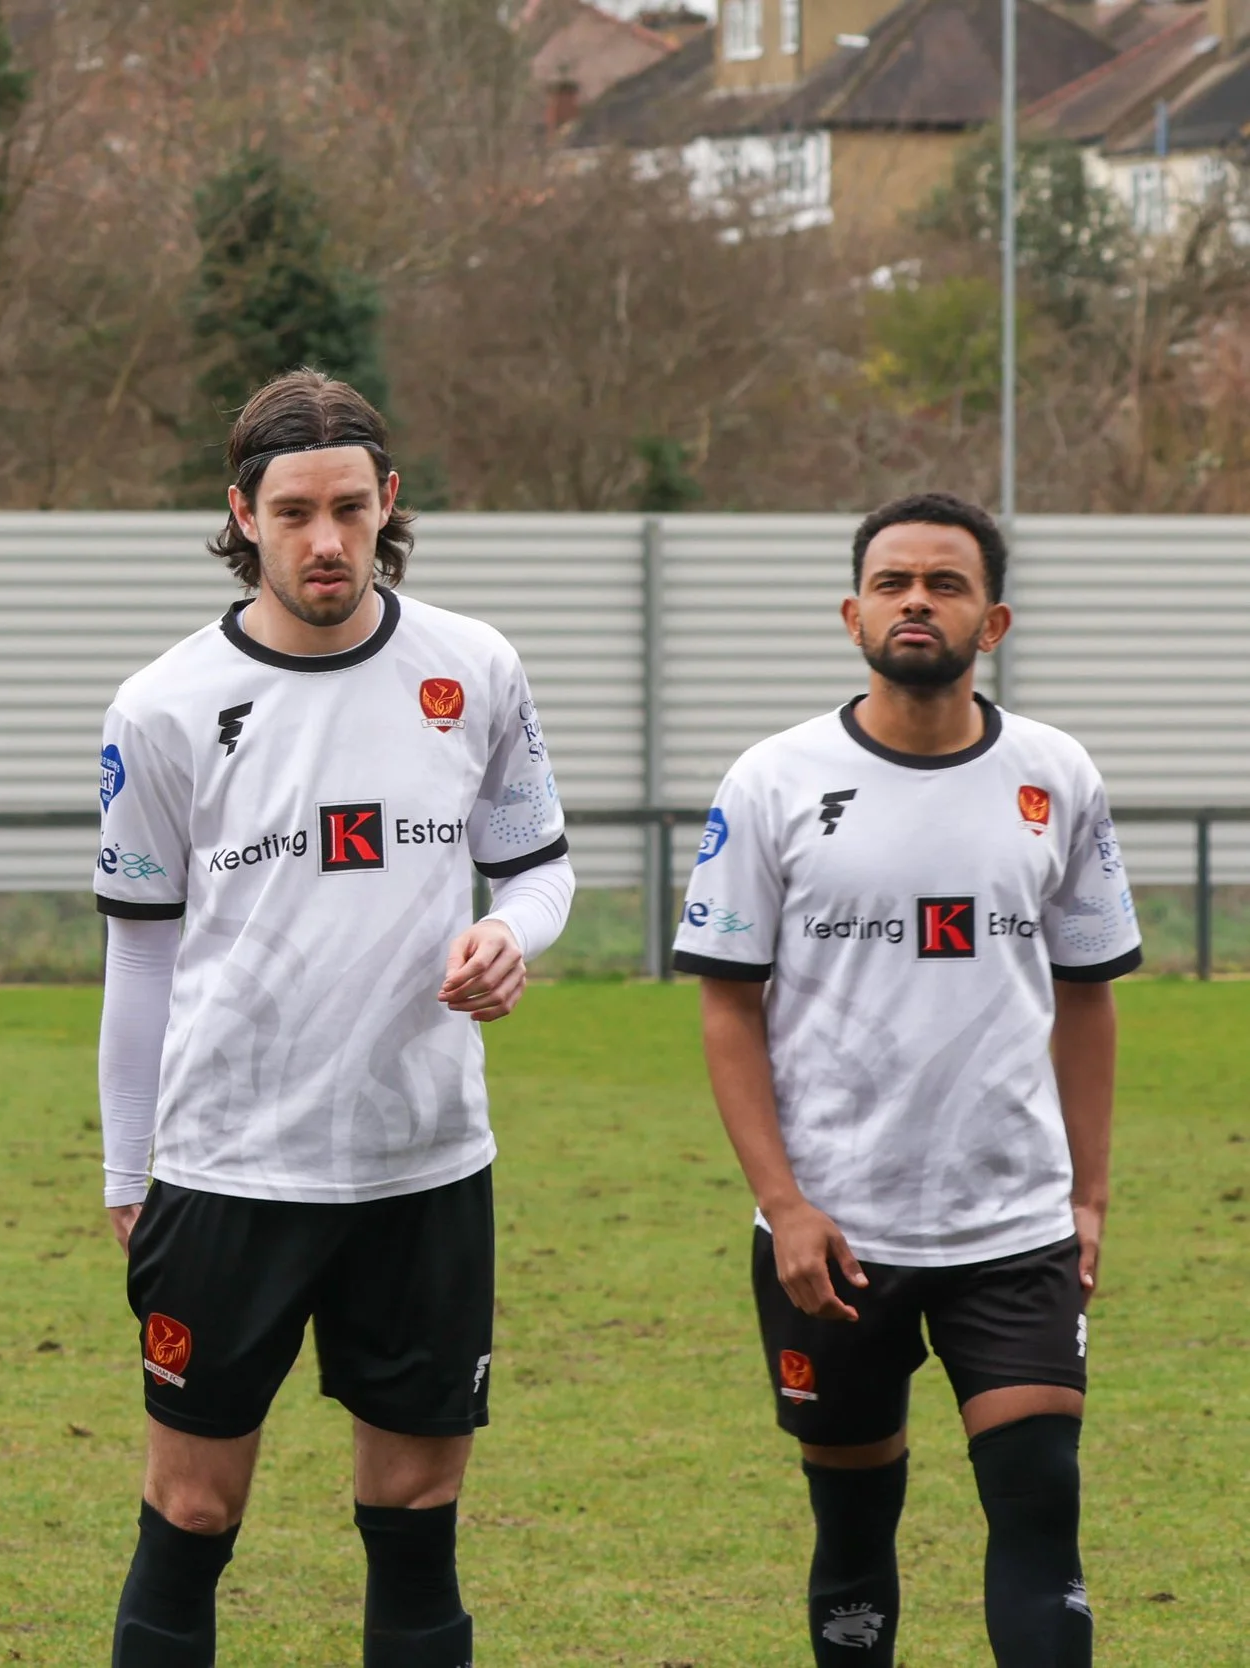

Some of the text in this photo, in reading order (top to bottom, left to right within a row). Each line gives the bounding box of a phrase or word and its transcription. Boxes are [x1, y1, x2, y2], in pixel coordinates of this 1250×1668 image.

[209, 811, 464, 873] Keating K Estat
[803, 904, 1039, 951] Keating K Esta
